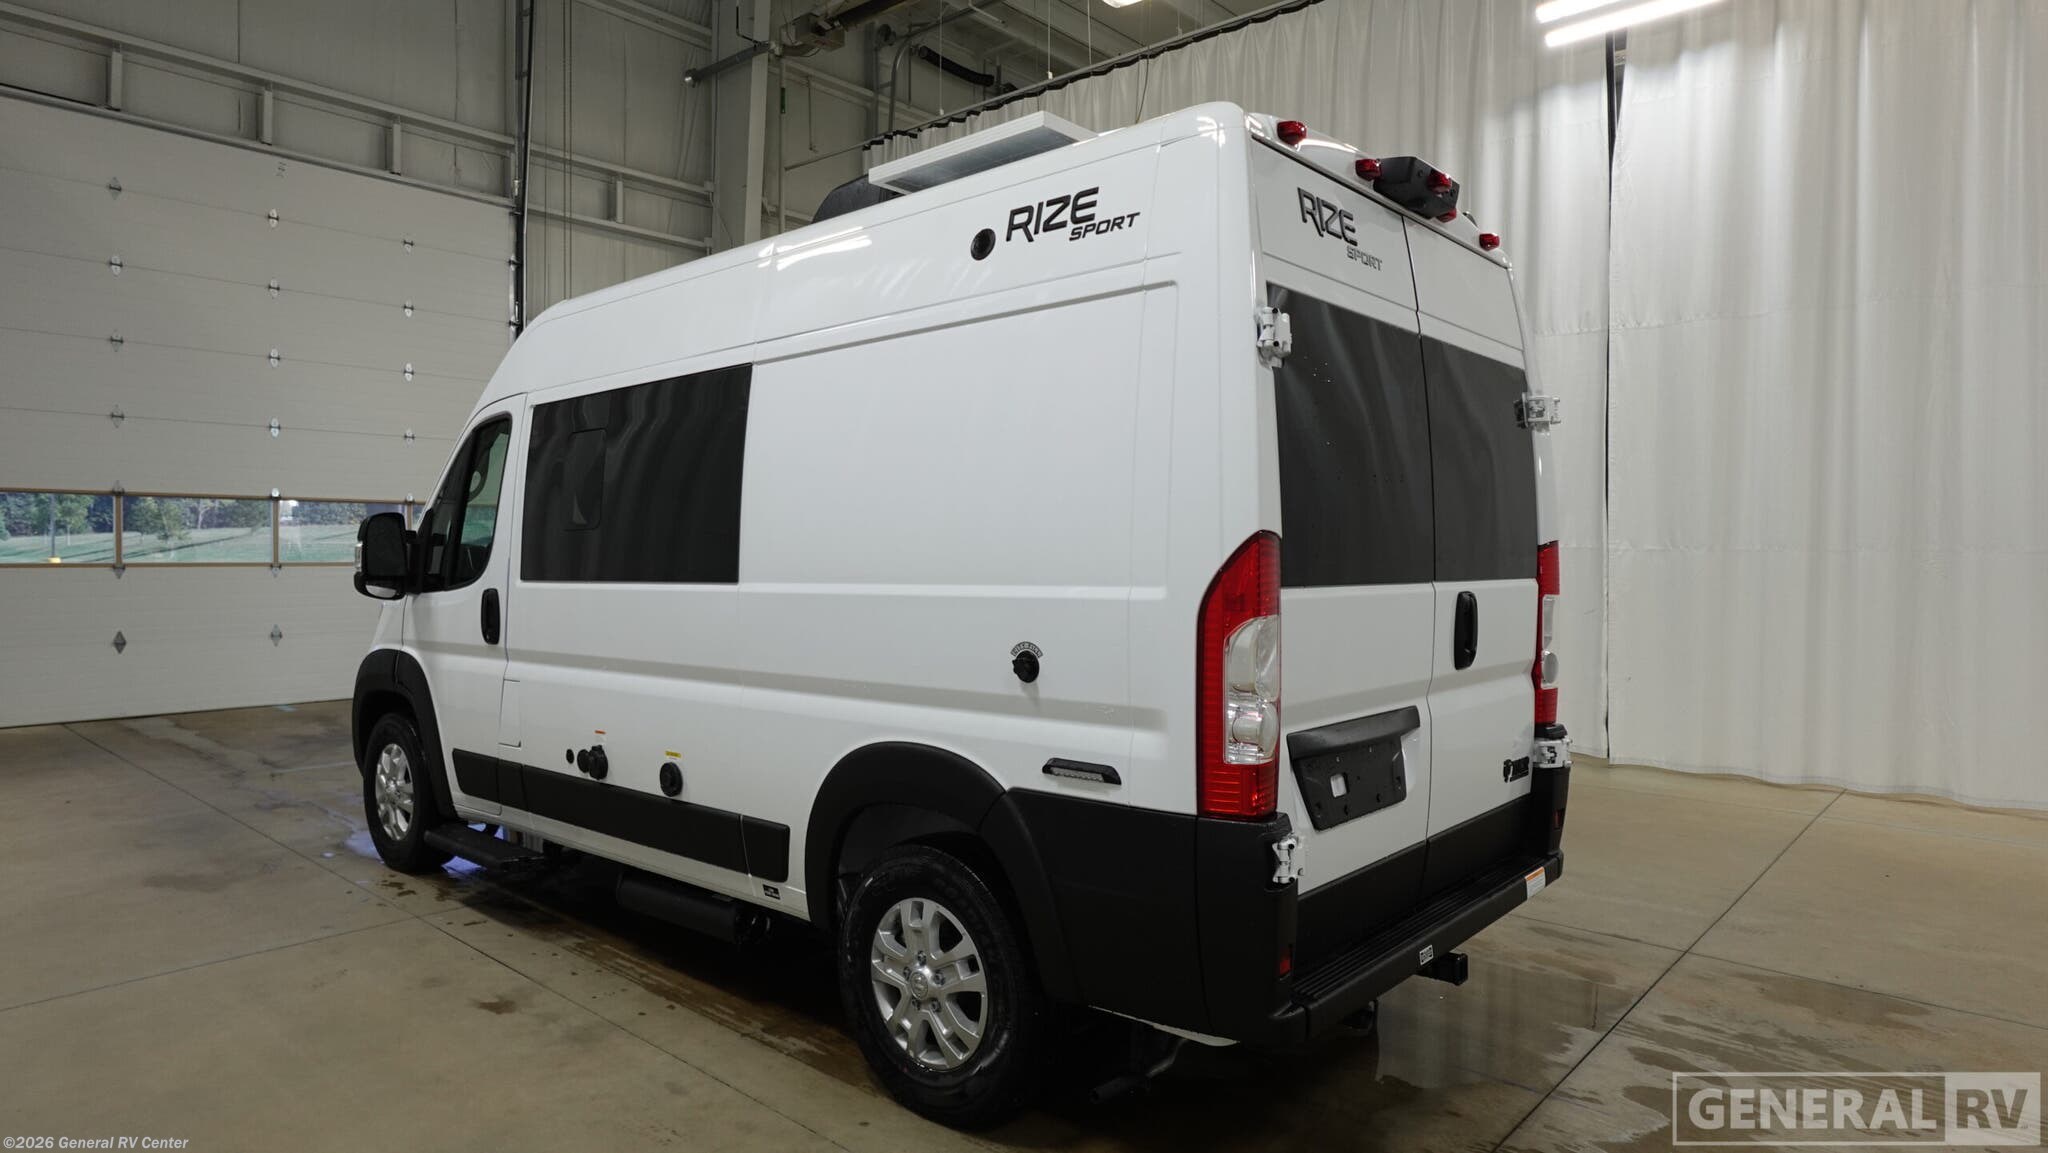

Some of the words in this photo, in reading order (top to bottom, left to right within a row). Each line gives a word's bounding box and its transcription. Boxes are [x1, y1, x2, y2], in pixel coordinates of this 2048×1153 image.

[1006, 187, 1099, 242] RIZE
[1069, 212, 1141, 241] SPORT
[1297, 187, 1358, 246] RIZE
[1346, 245, 1382, 271] SPORT
